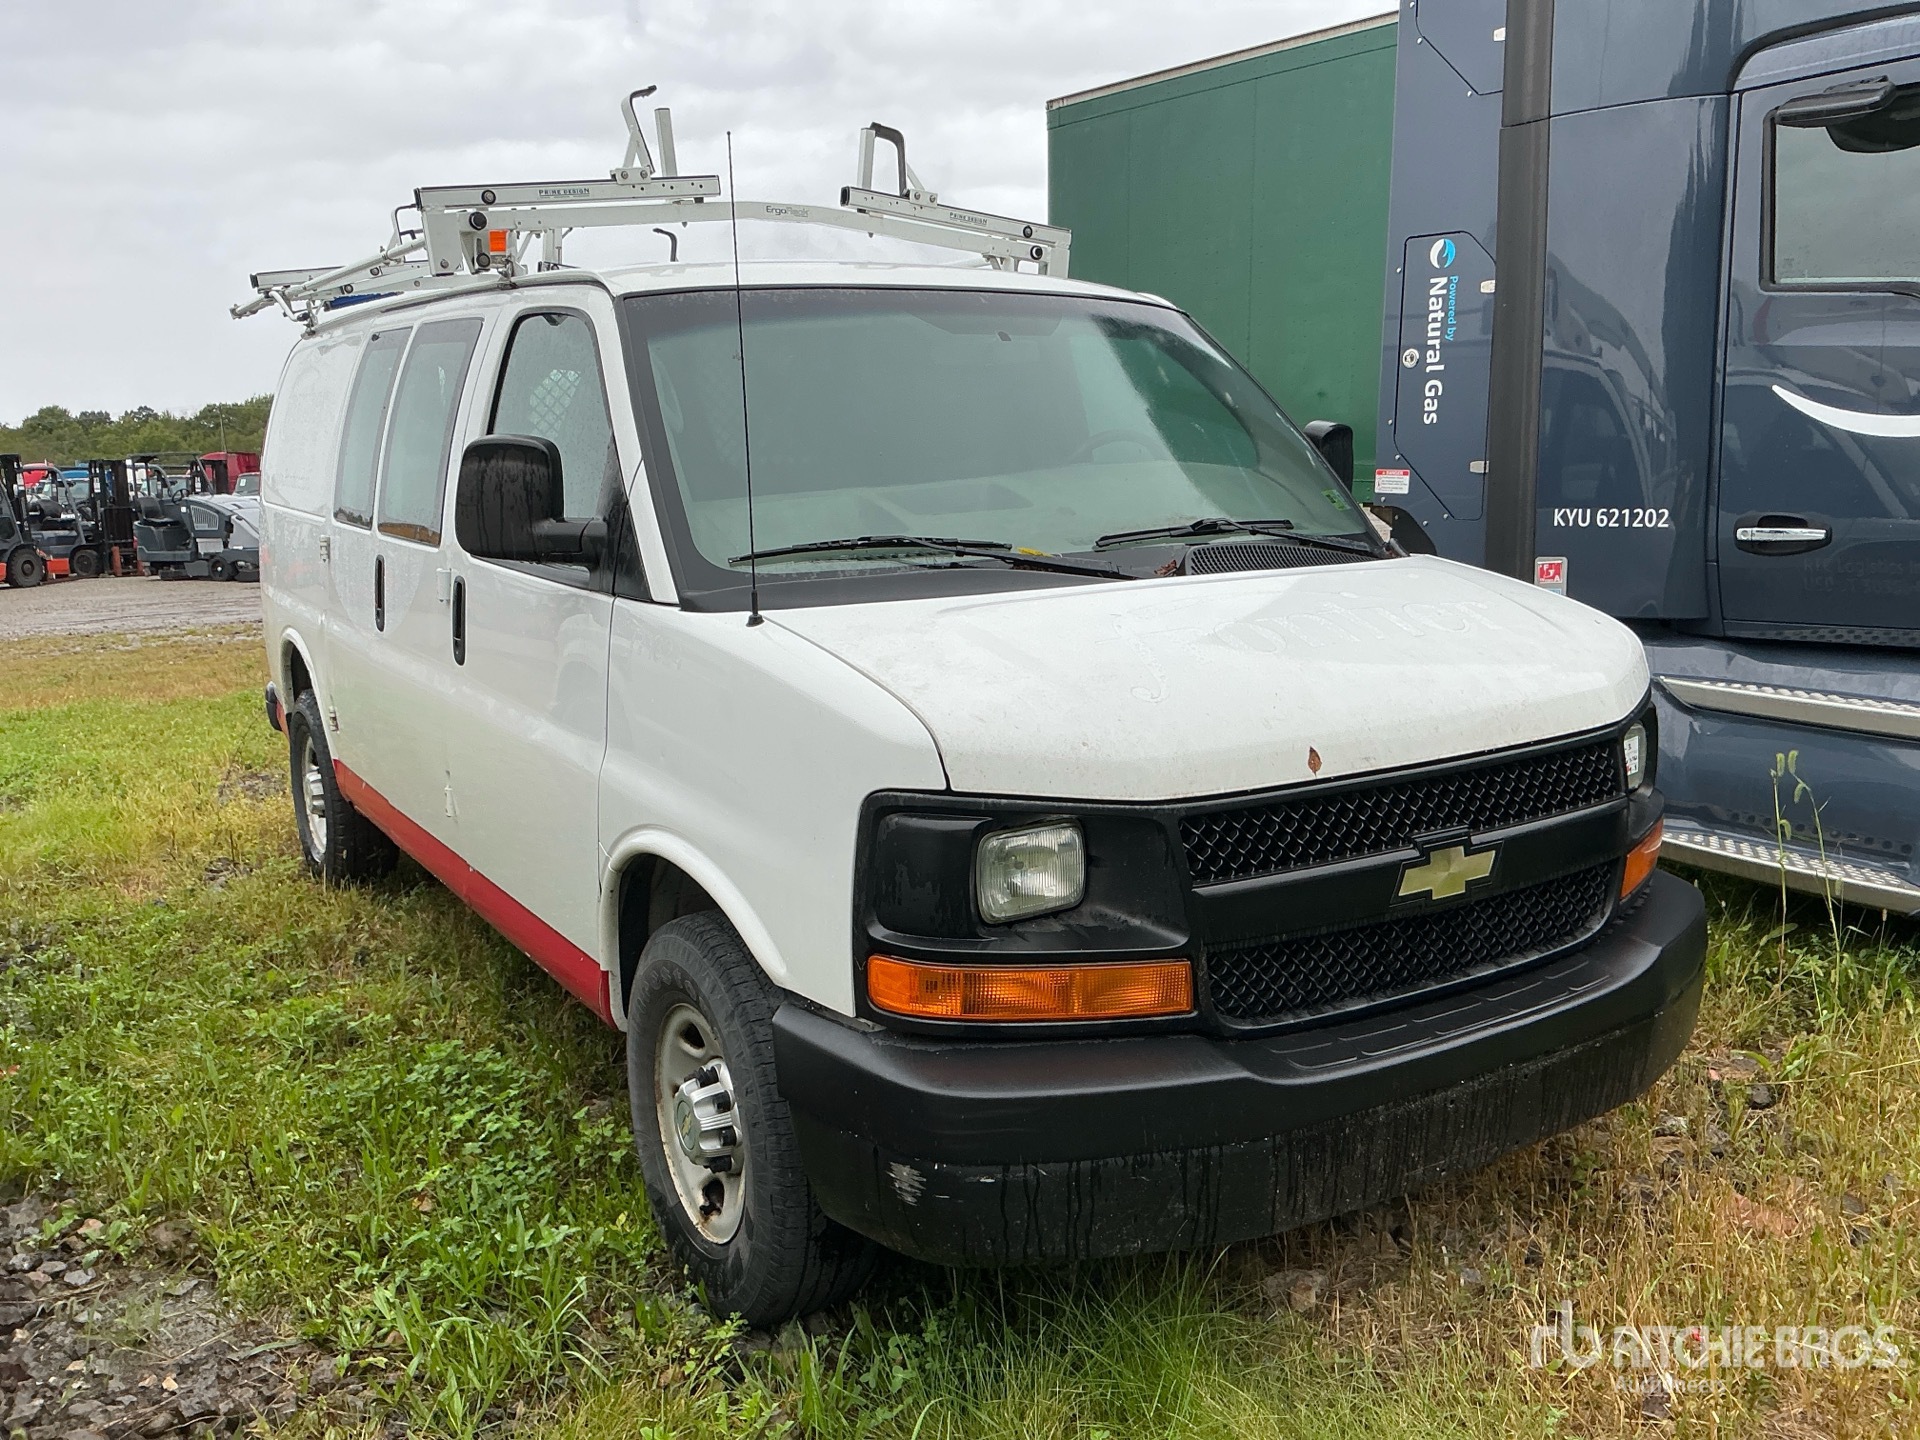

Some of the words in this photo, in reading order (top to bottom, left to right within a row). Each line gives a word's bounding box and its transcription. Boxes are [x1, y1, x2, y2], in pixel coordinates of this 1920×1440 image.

[563, 188, 590, 196] DESIGN
[1447, 275, 1459, 325] Powered
[1425, 277, 1448, 373] Natural
[1445, 327, 1457, 342] by
[1423, 379, 1443, 425] Gas
[1553, 508, 1591, 527] KYU
[1596, 508, 1669, 528] 621202
